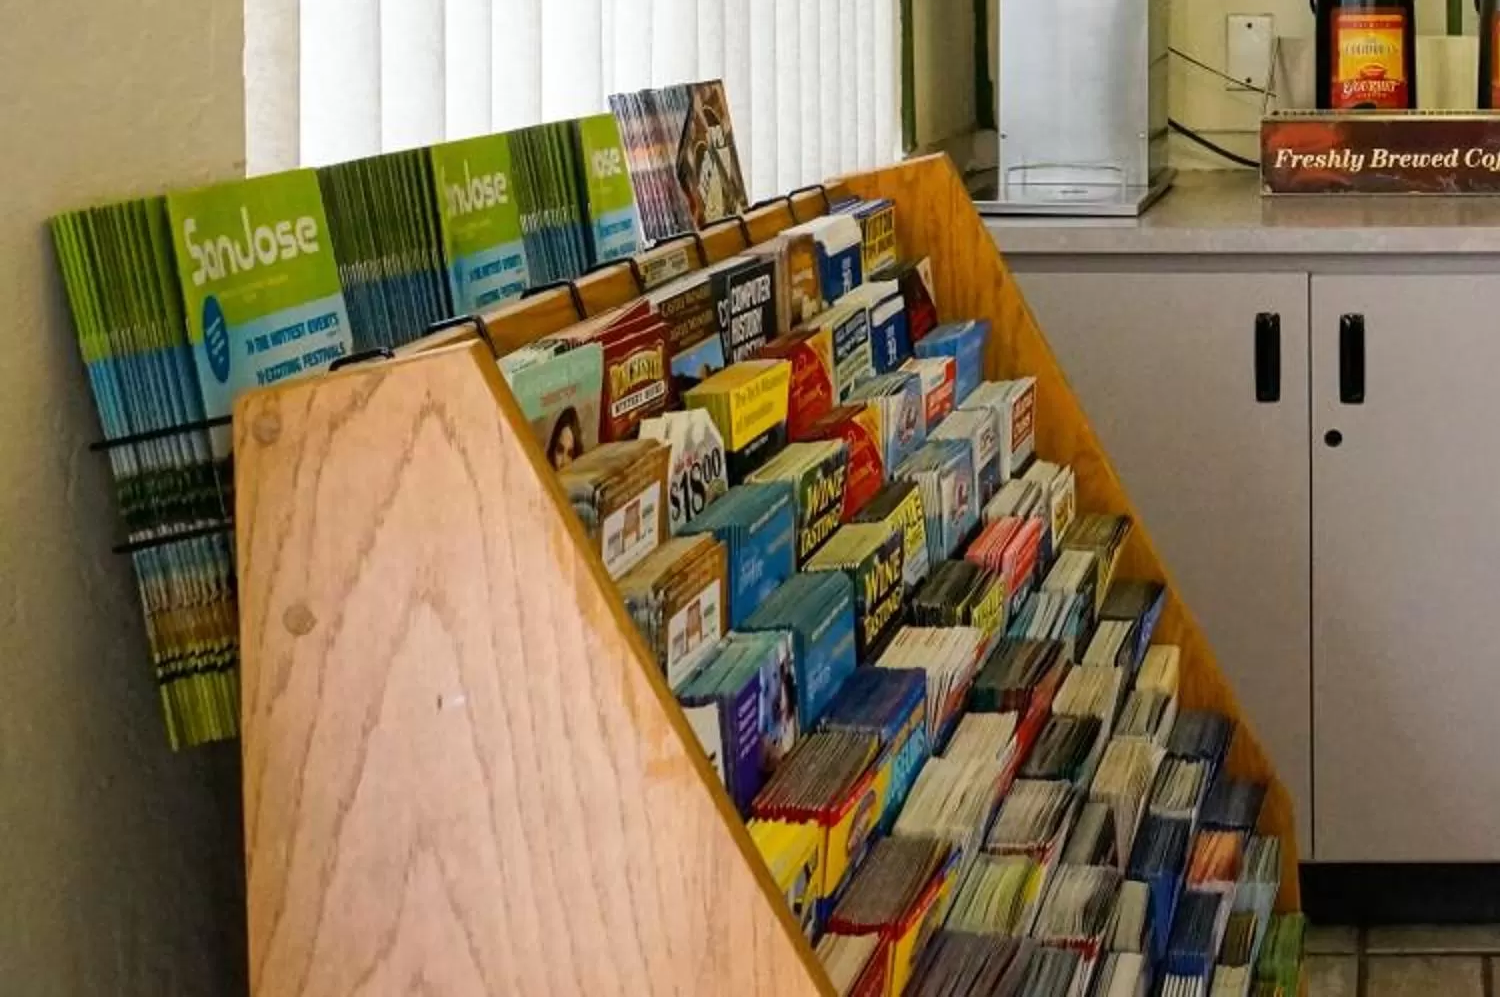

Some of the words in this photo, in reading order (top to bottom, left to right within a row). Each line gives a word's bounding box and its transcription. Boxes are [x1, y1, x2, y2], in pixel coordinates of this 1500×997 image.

[1274, 148, 1363, 172] Freshly
[1371, 148, 1458, 169] Brewed
[731, 274, 771, 314] COMPUTER
[731, 306, 763, 345] HISTORY
[807, 465, 846, 523] WINE
[865, 546, 902, 612] WINE
